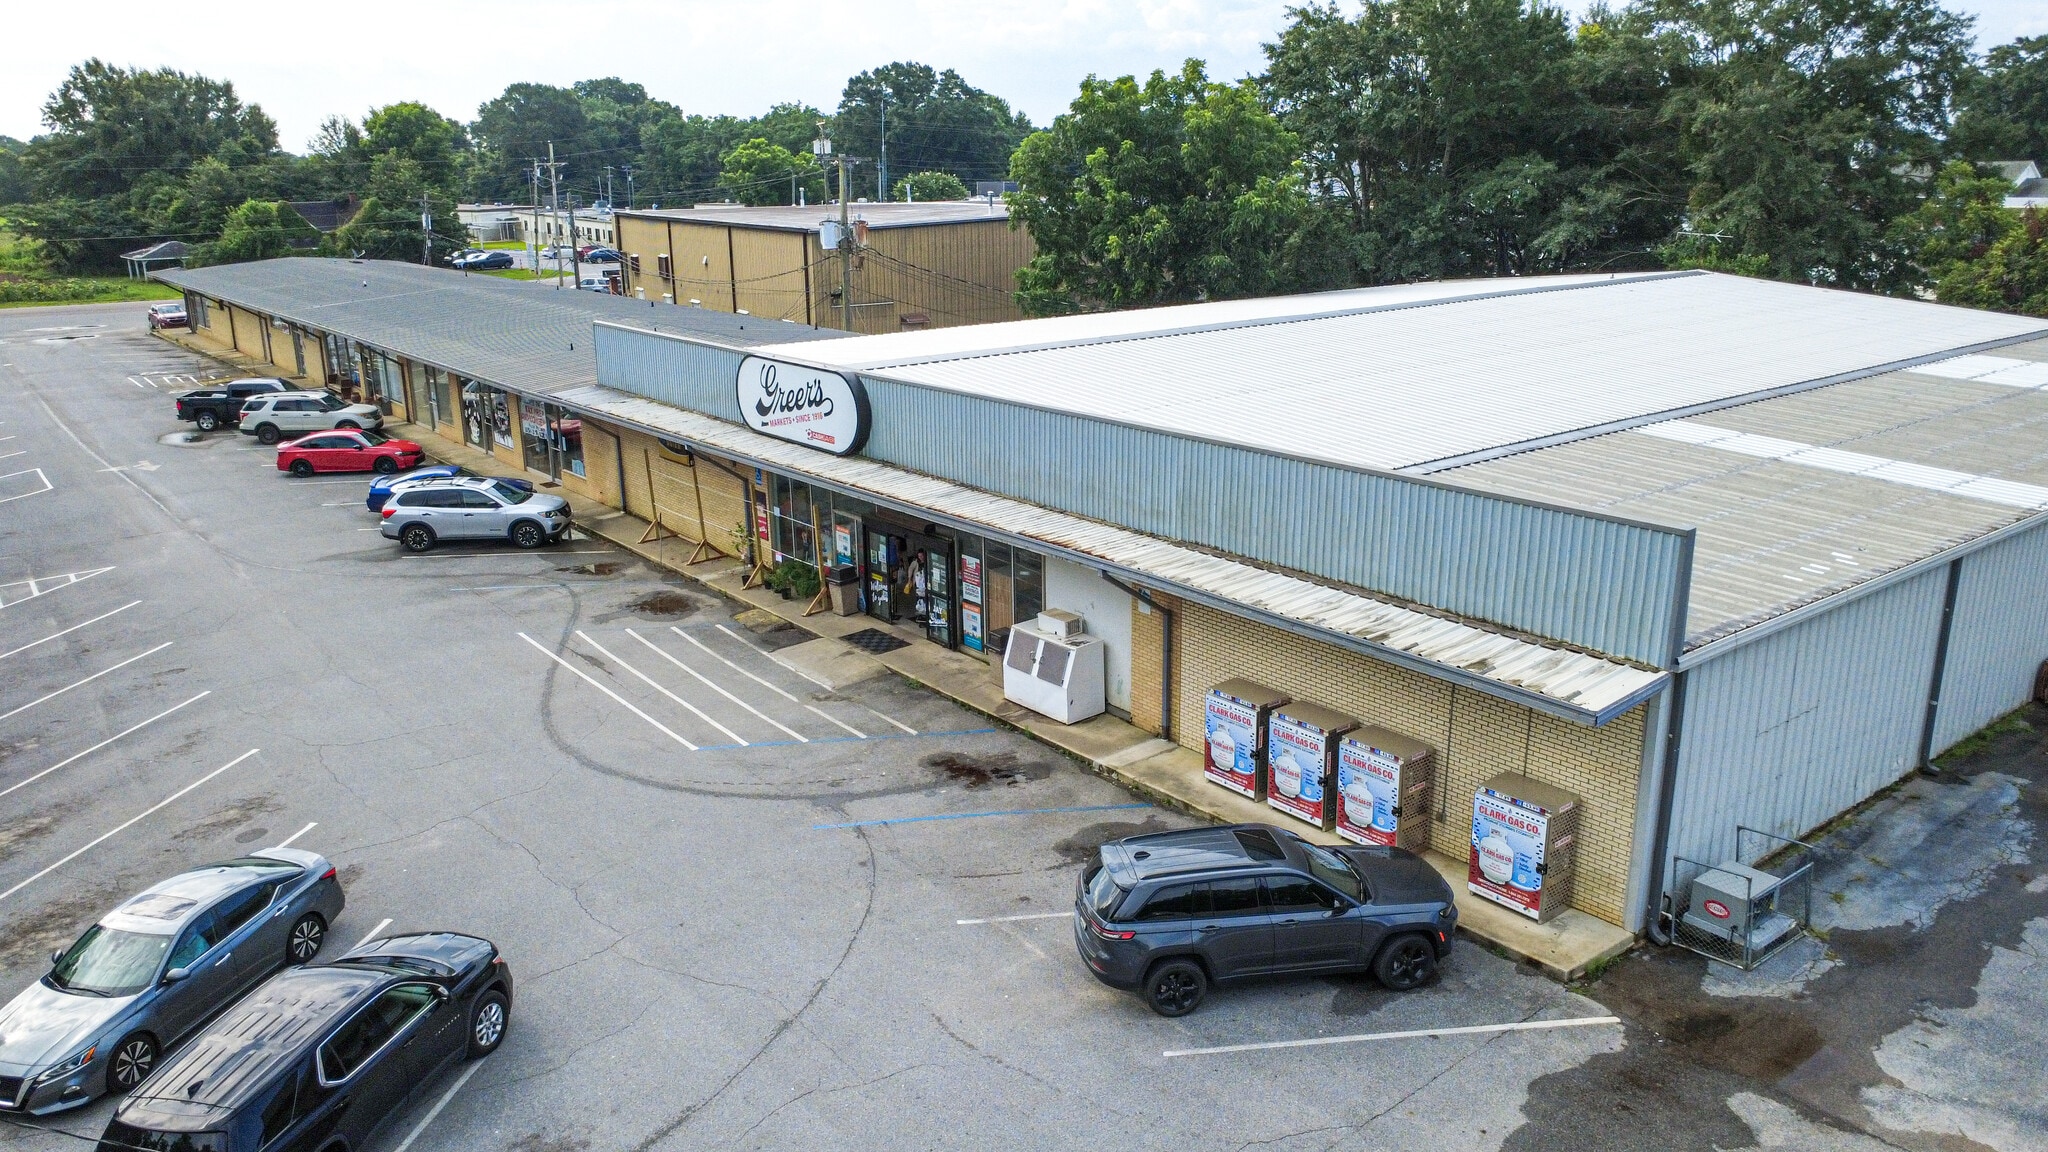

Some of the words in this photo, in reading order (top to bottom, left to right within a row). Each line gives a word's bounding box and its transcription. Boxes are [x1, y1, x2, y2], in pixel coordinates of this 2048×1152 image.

[756, 363, 834, 417] Greer's
[770, 416, 792, 428] MARKETS
[796, 414, 810, 424] SINCE
[1208, 704, 1229, 718] CLARK
[1229, 712, 1242, 723] GAS
[1273, 728, 1295, 742] CLARK
[1295, 737, 1308, 748] GAS
[1343, 754, 1367, 770] CLARK
[1368, 764, 1382, 775] GAS
[1478, 805, 1507, 823] CLARK
[1508, 816, 1525, 829] GAS
[1480, 846, 1495, 858] CLARK
[1495, 853, 1505, 862] GAS
